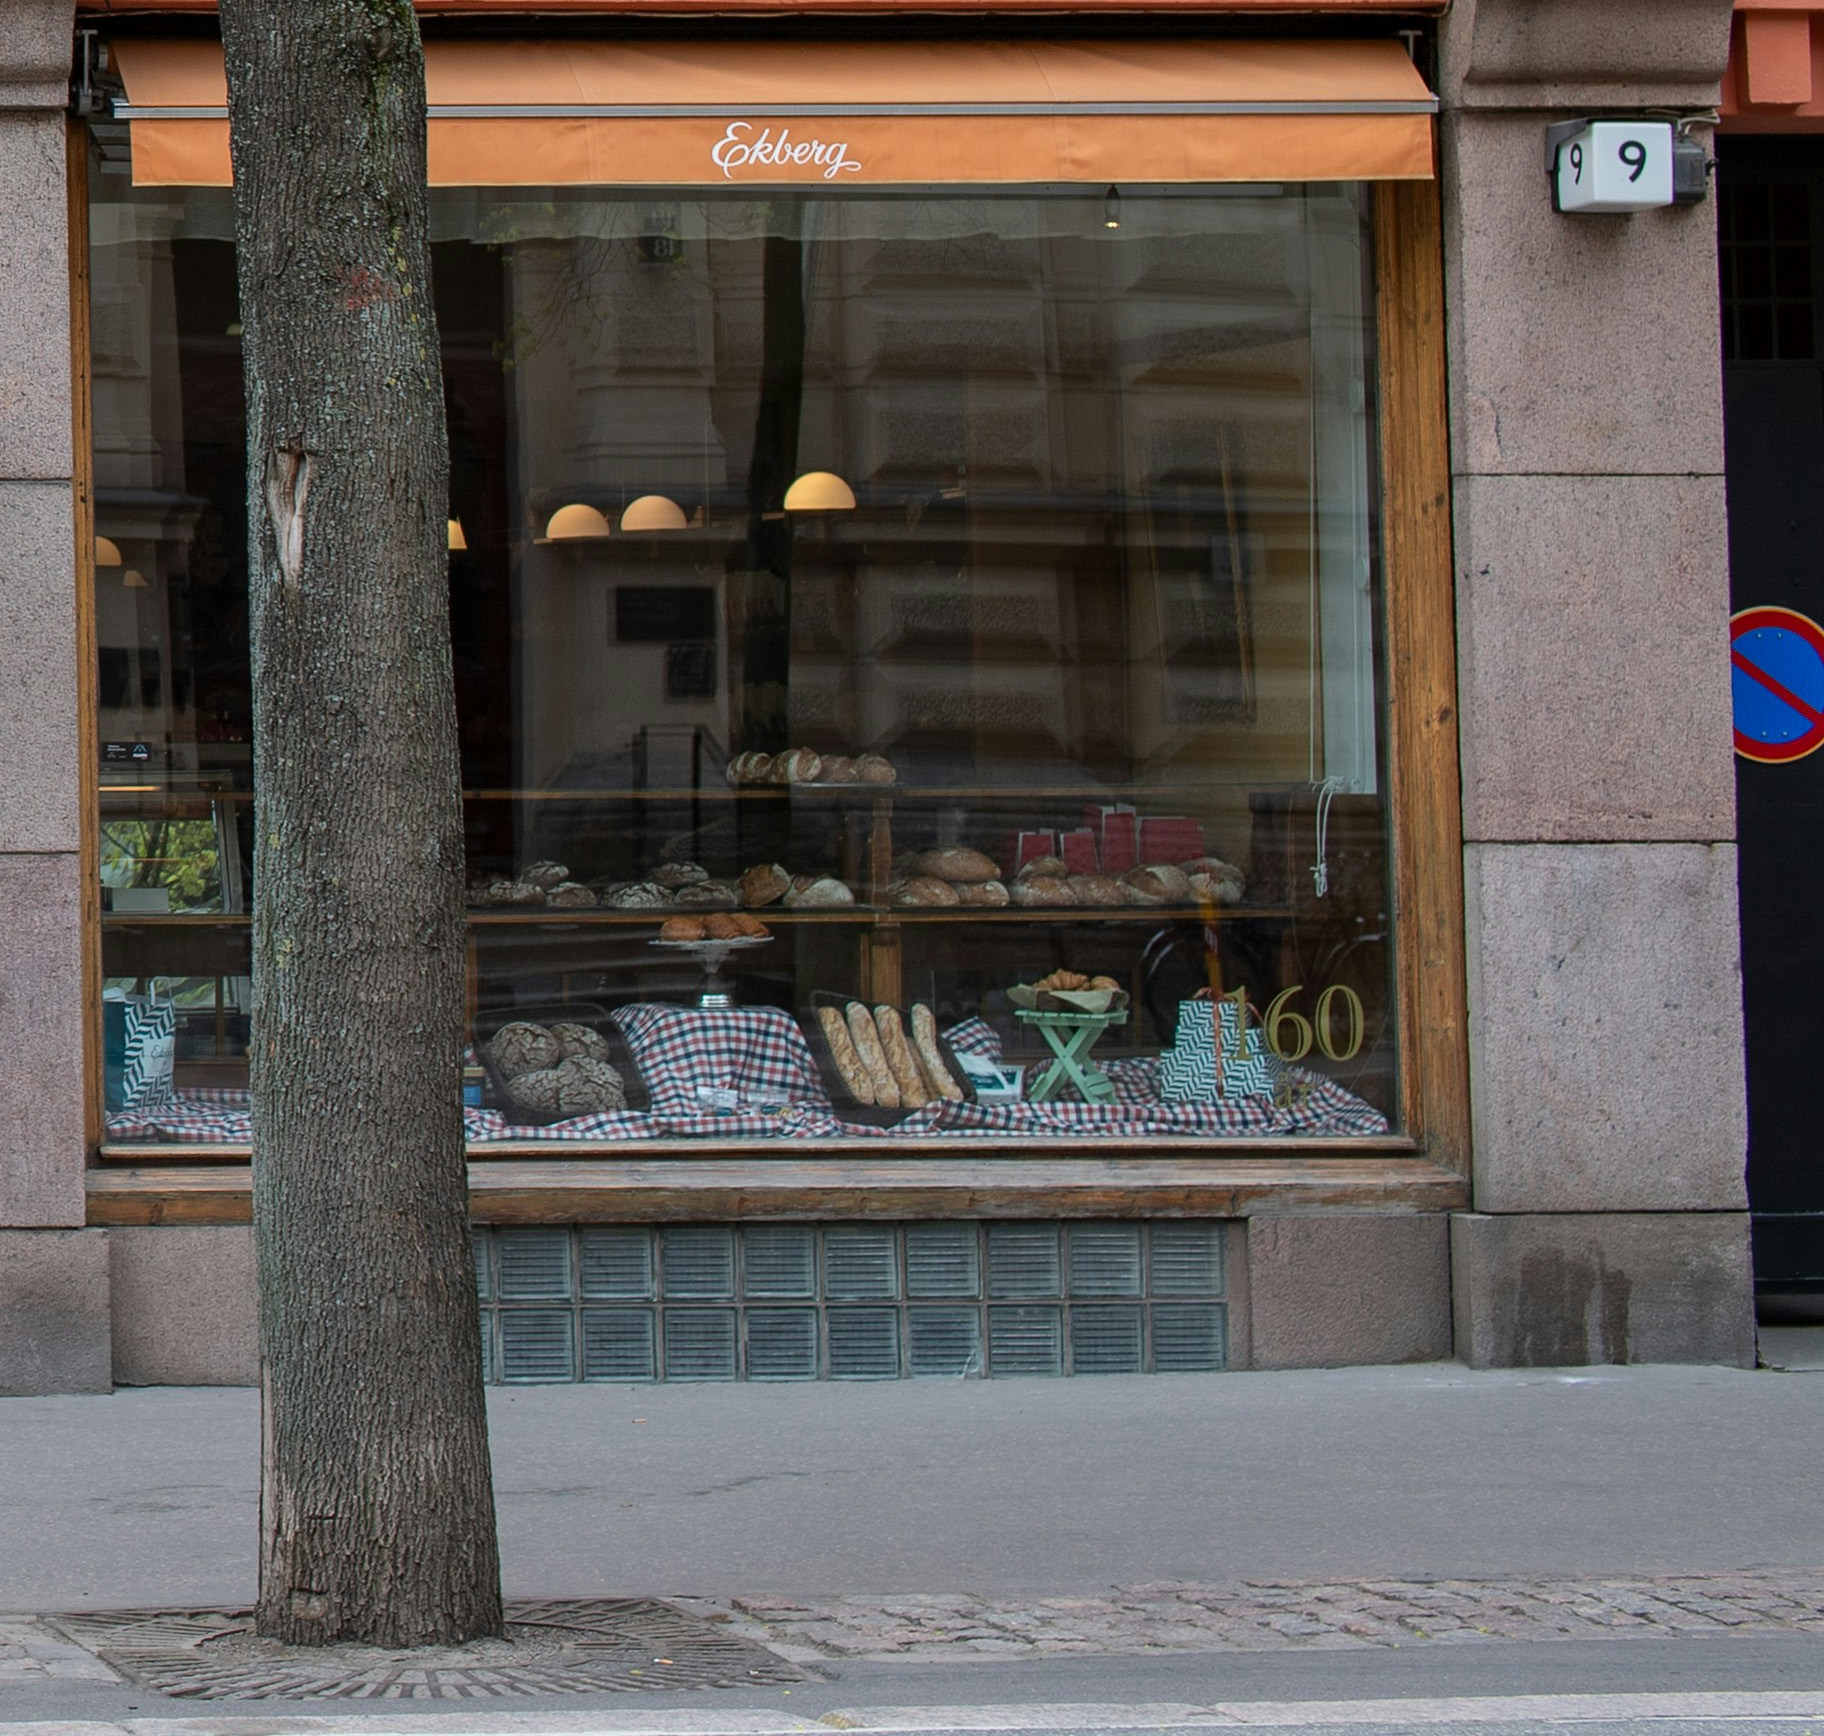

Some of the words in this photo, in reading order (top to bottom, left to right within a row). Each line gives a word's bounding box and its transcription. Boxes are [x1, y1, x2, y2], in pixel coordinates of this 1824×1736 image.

[711, 121, 862, 179] Ekberg
[1569, 142, 1583, 186] 9
[1618, 140, 1647, 183] 9
[1222, 984, 1364, 1062] 160
